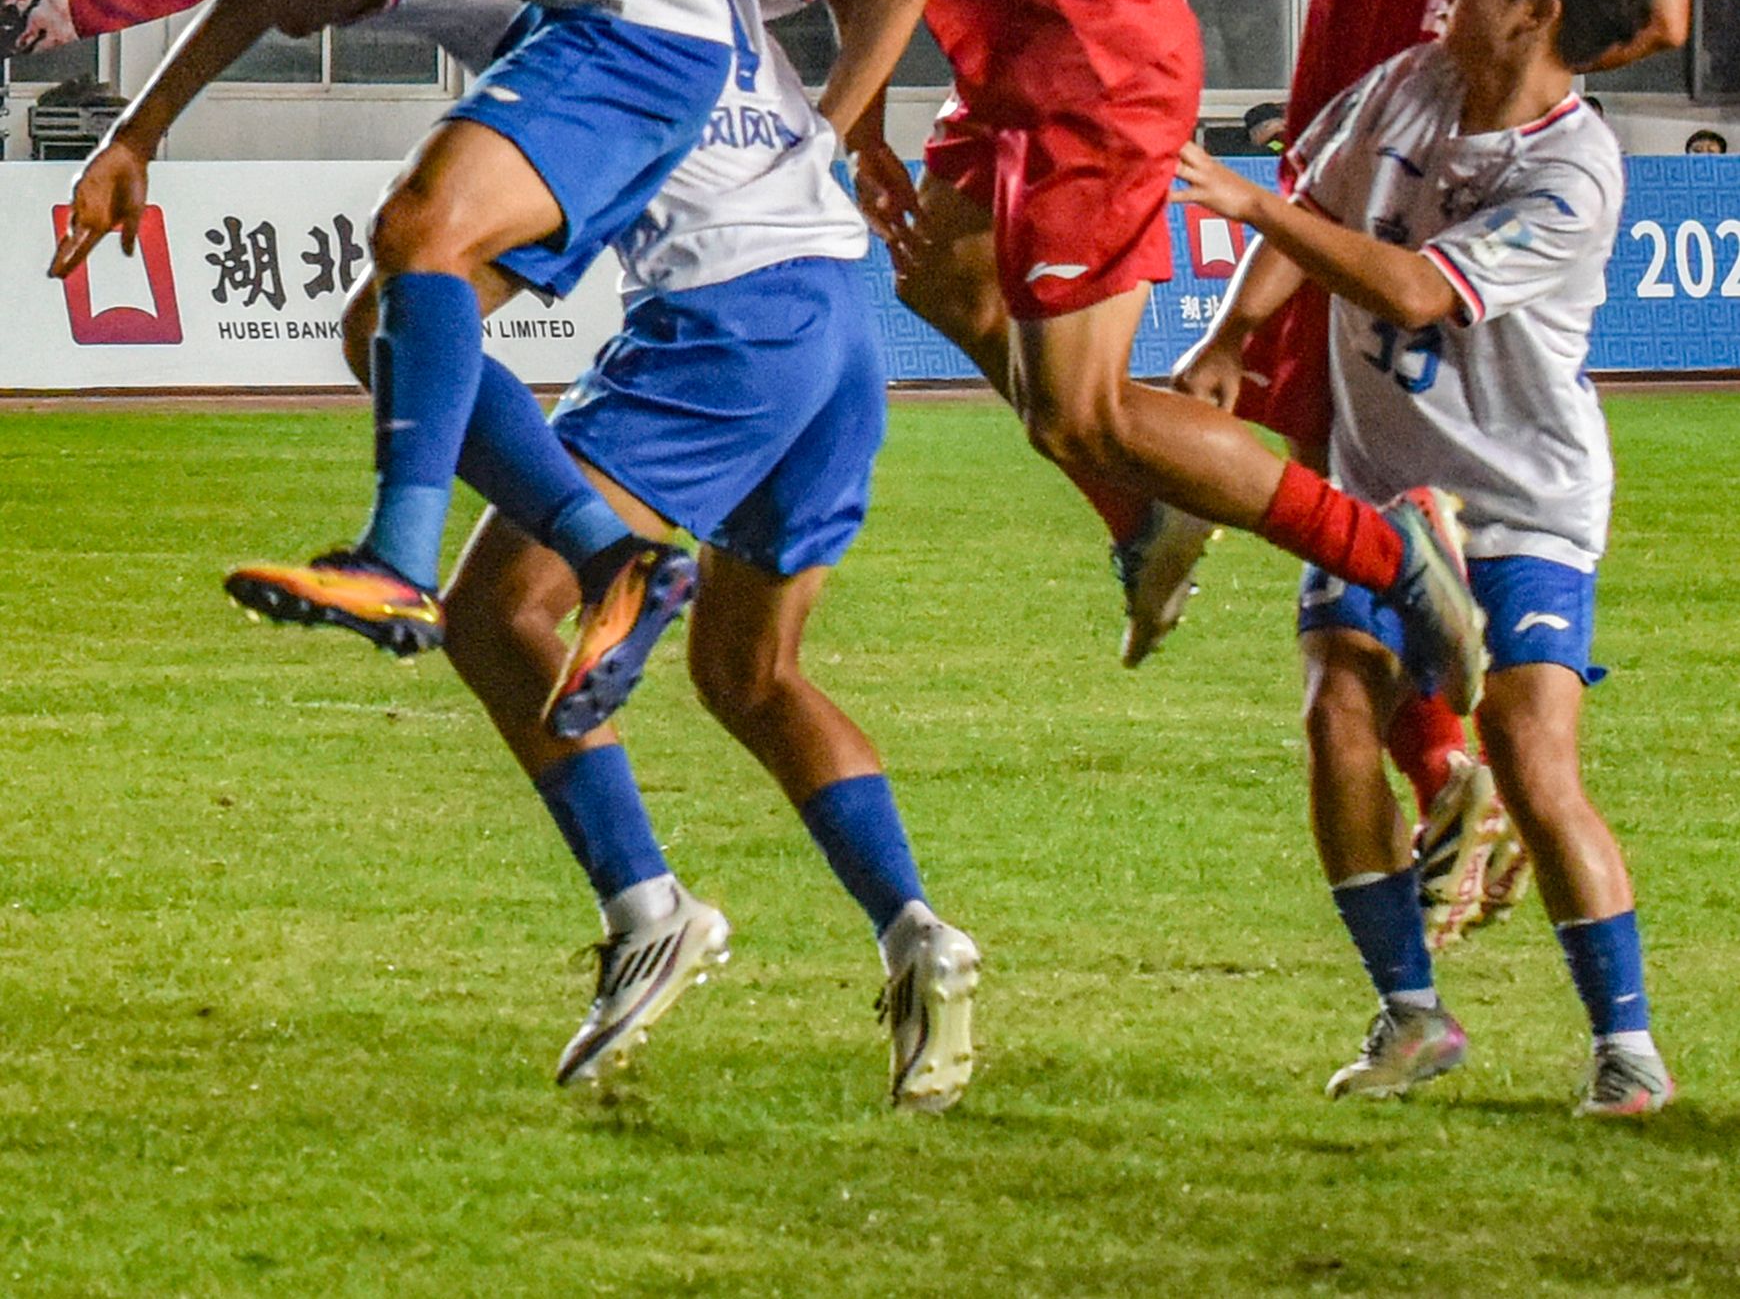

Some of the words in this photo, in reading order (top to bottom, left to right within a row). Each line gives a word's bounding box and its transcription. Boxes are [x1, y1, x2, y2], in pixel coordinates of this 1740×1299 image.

[205, 213, 364, 311] 湖北
[218, 321, 280, 339] HUBEI
[287, 321, 342, 340] BANK
[500, 319, 576, 339] LIMITED
